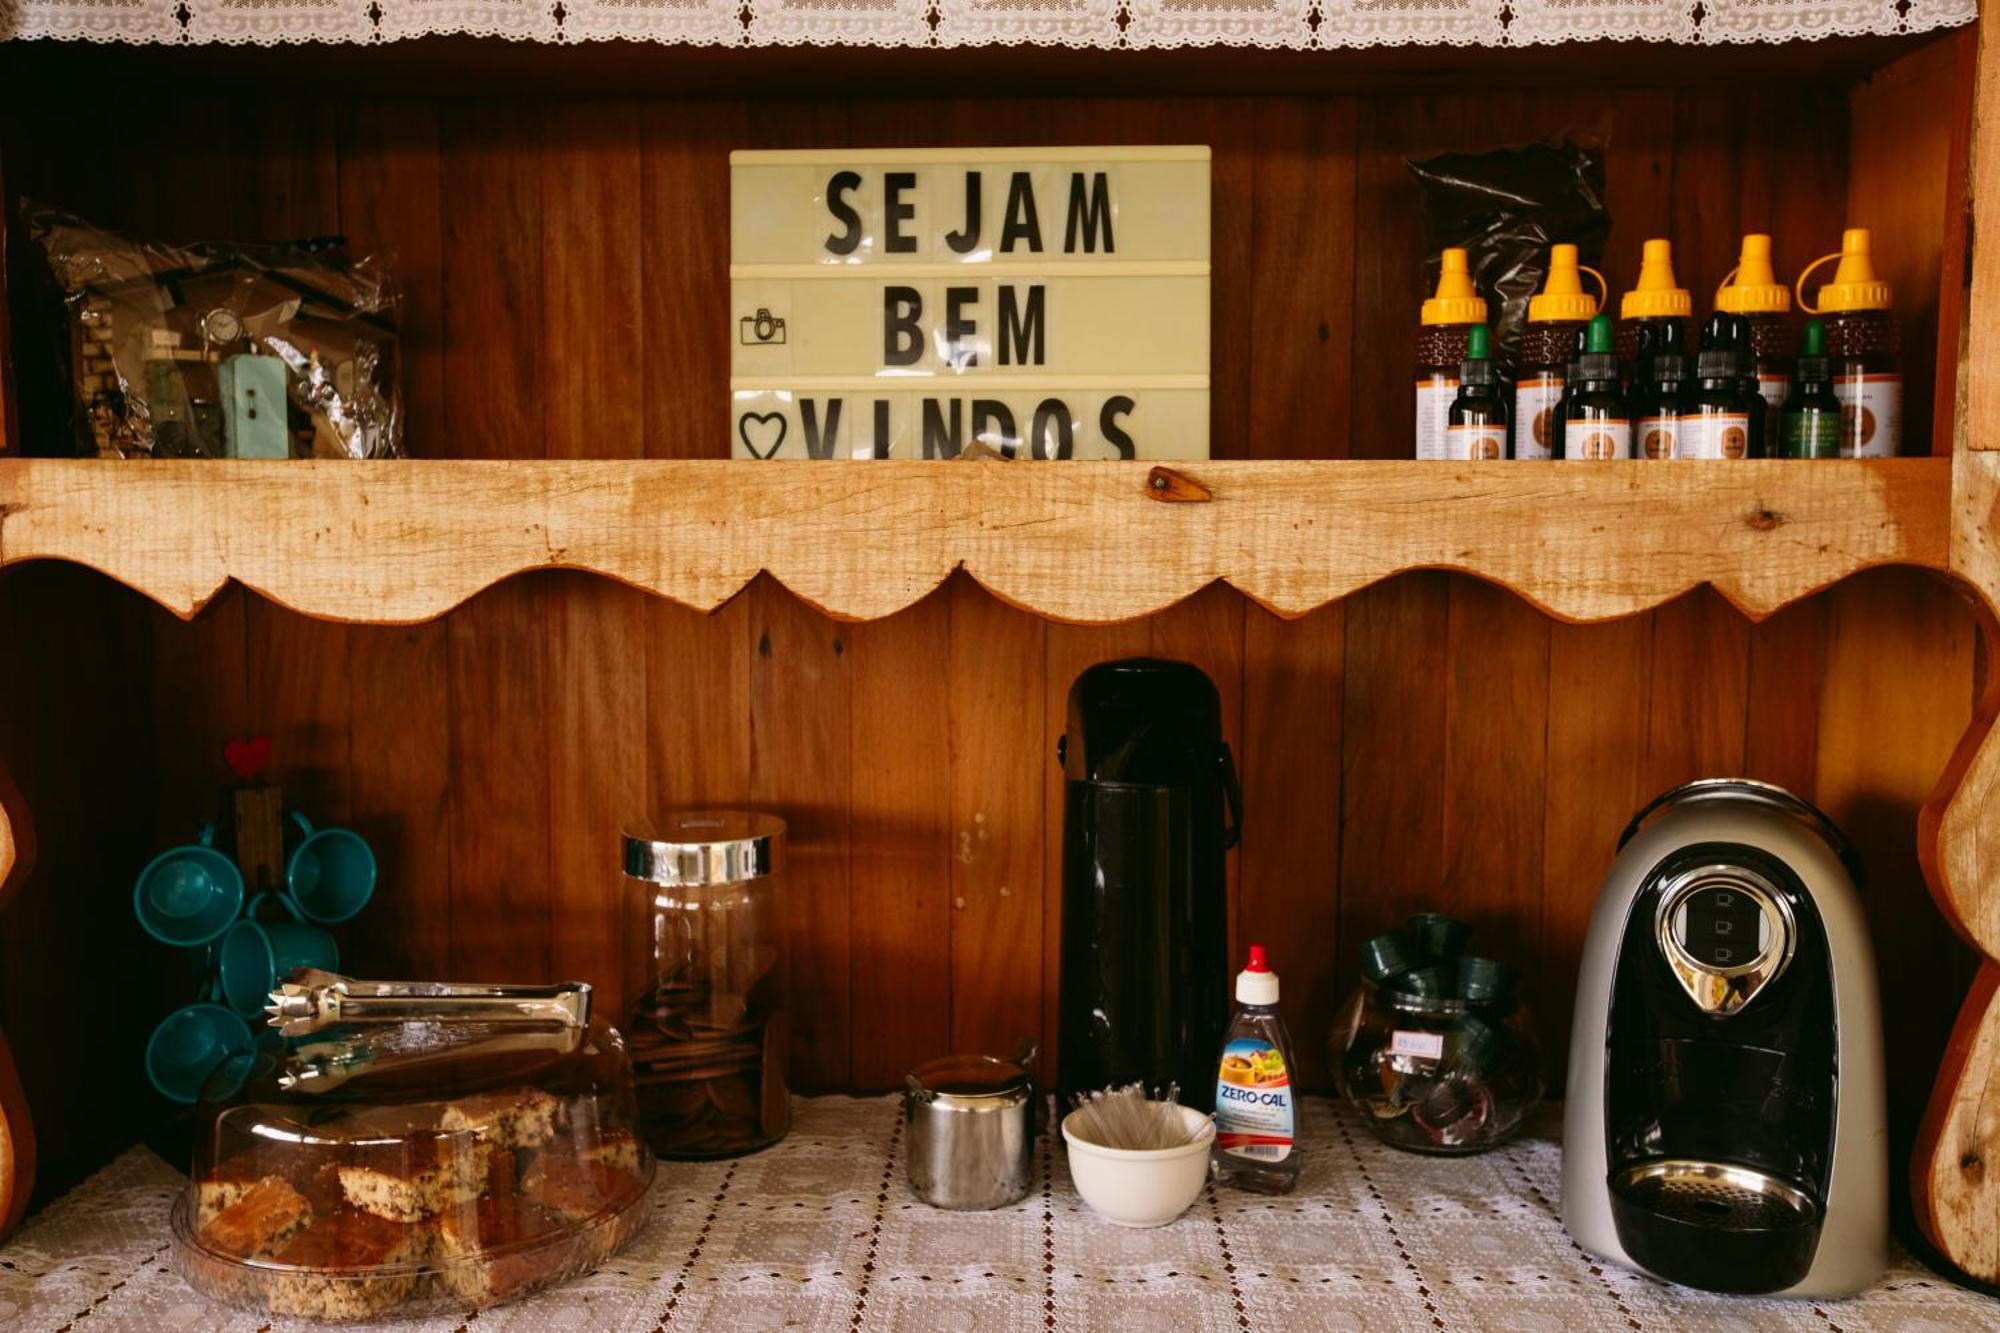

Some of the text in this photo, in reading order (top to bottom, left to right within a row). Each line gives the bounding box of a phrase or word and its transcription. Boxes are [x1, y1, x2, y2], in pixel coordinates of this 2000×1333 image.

[824, 170, 1115, 256] SEJAM
[884, 284, 1046, 367] BEM
[799, 395, 1137, 461] VINDOS
[1221, 1084, 1287, 1107] ZERO-CAL
